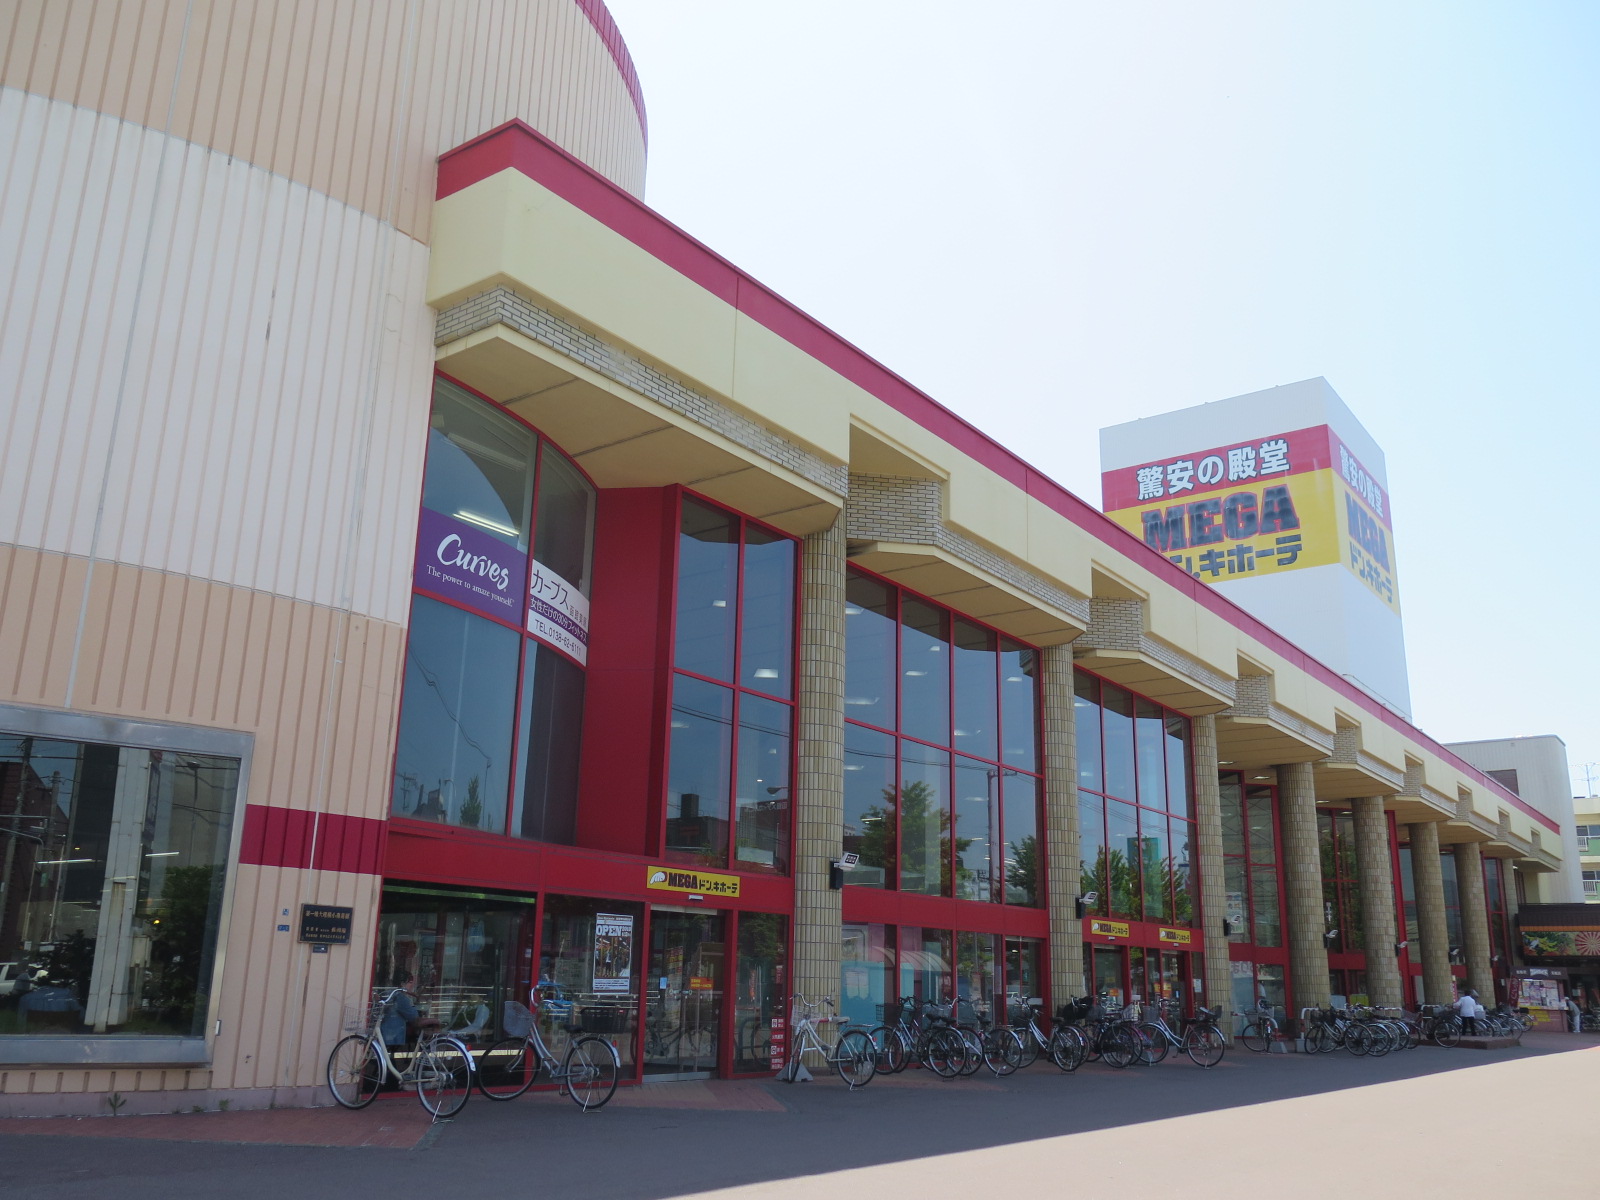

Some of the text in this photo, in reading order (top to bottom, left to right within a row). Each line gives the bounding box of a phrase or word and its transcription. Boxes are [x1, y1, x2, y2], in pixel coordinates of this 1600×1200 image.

[1136, 438, 1291, 502] 驚安の殿堂
[1141, 484, 1301, 554] MEGA
[426, 564, 442, 578] The
[442, 573, 463, 586] power
[464, 581, 471, 589] to
[472, 585, 490, 597] amaze
[437, 533, 509, 590] Curves
[667, 872, 698, 890] MEGA
[596, 924, 622, 937] OPEN
